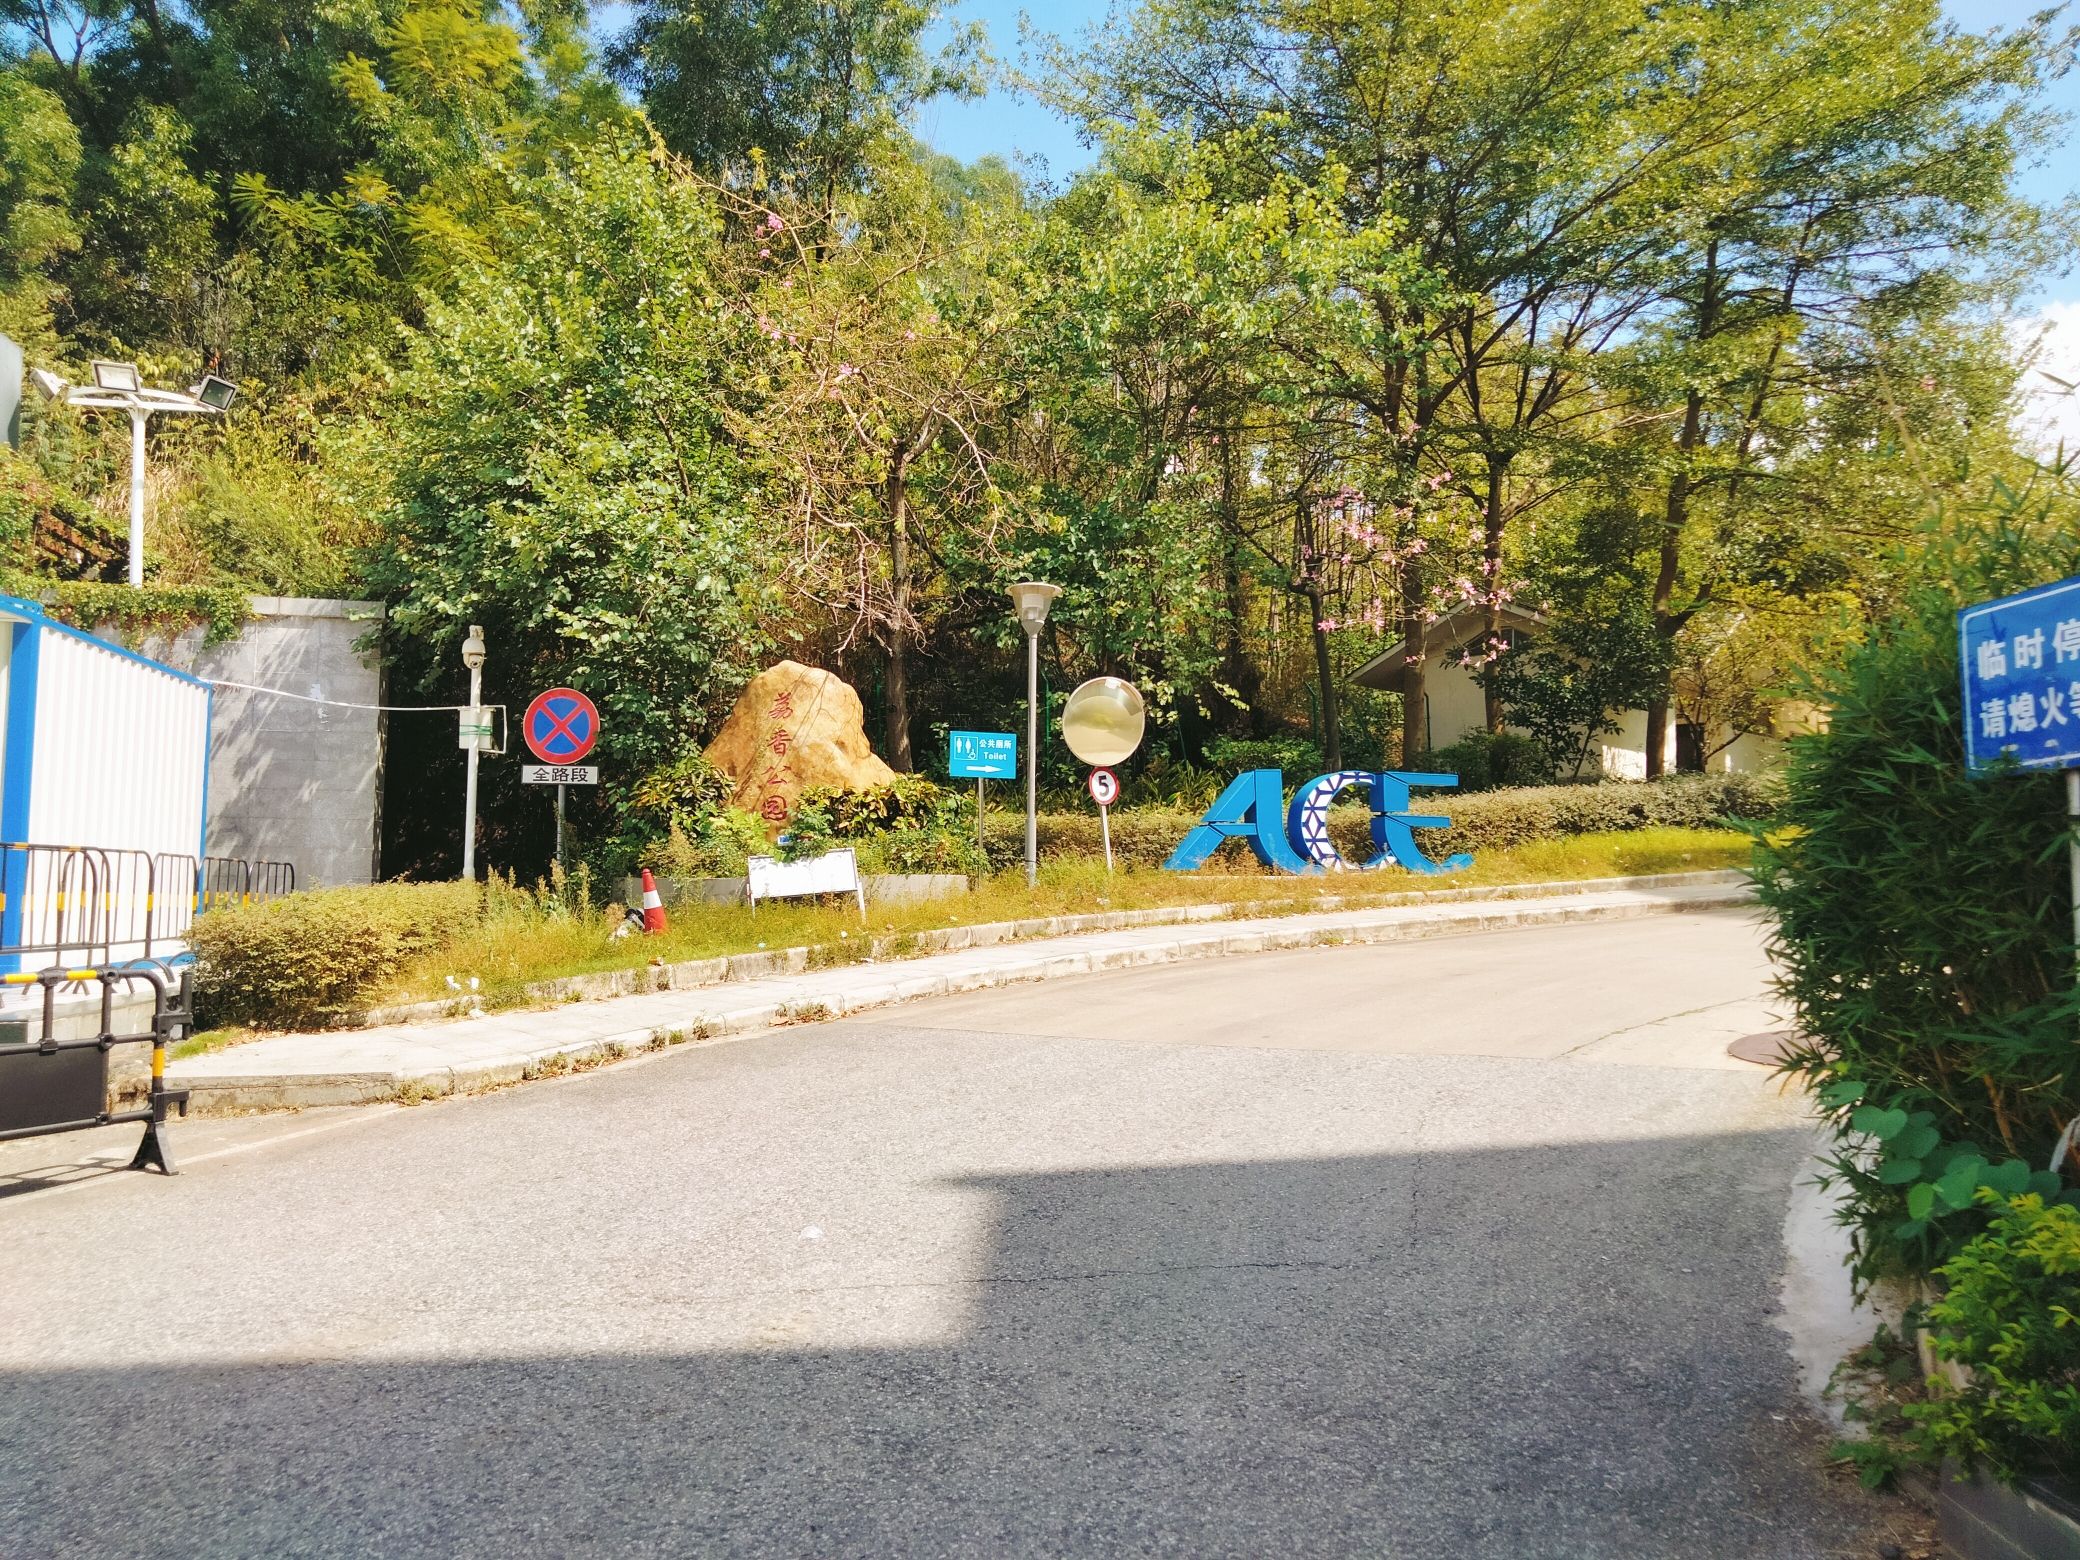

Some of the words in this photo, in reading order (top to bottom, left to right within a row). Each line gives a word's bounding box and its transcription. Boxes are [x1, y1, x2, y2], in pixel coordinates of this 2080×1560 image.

[983, 751, 1007, 761] Toilet
[532, 767, 589, 782] 全路段
[1098, 774, 1110, 797] 5
